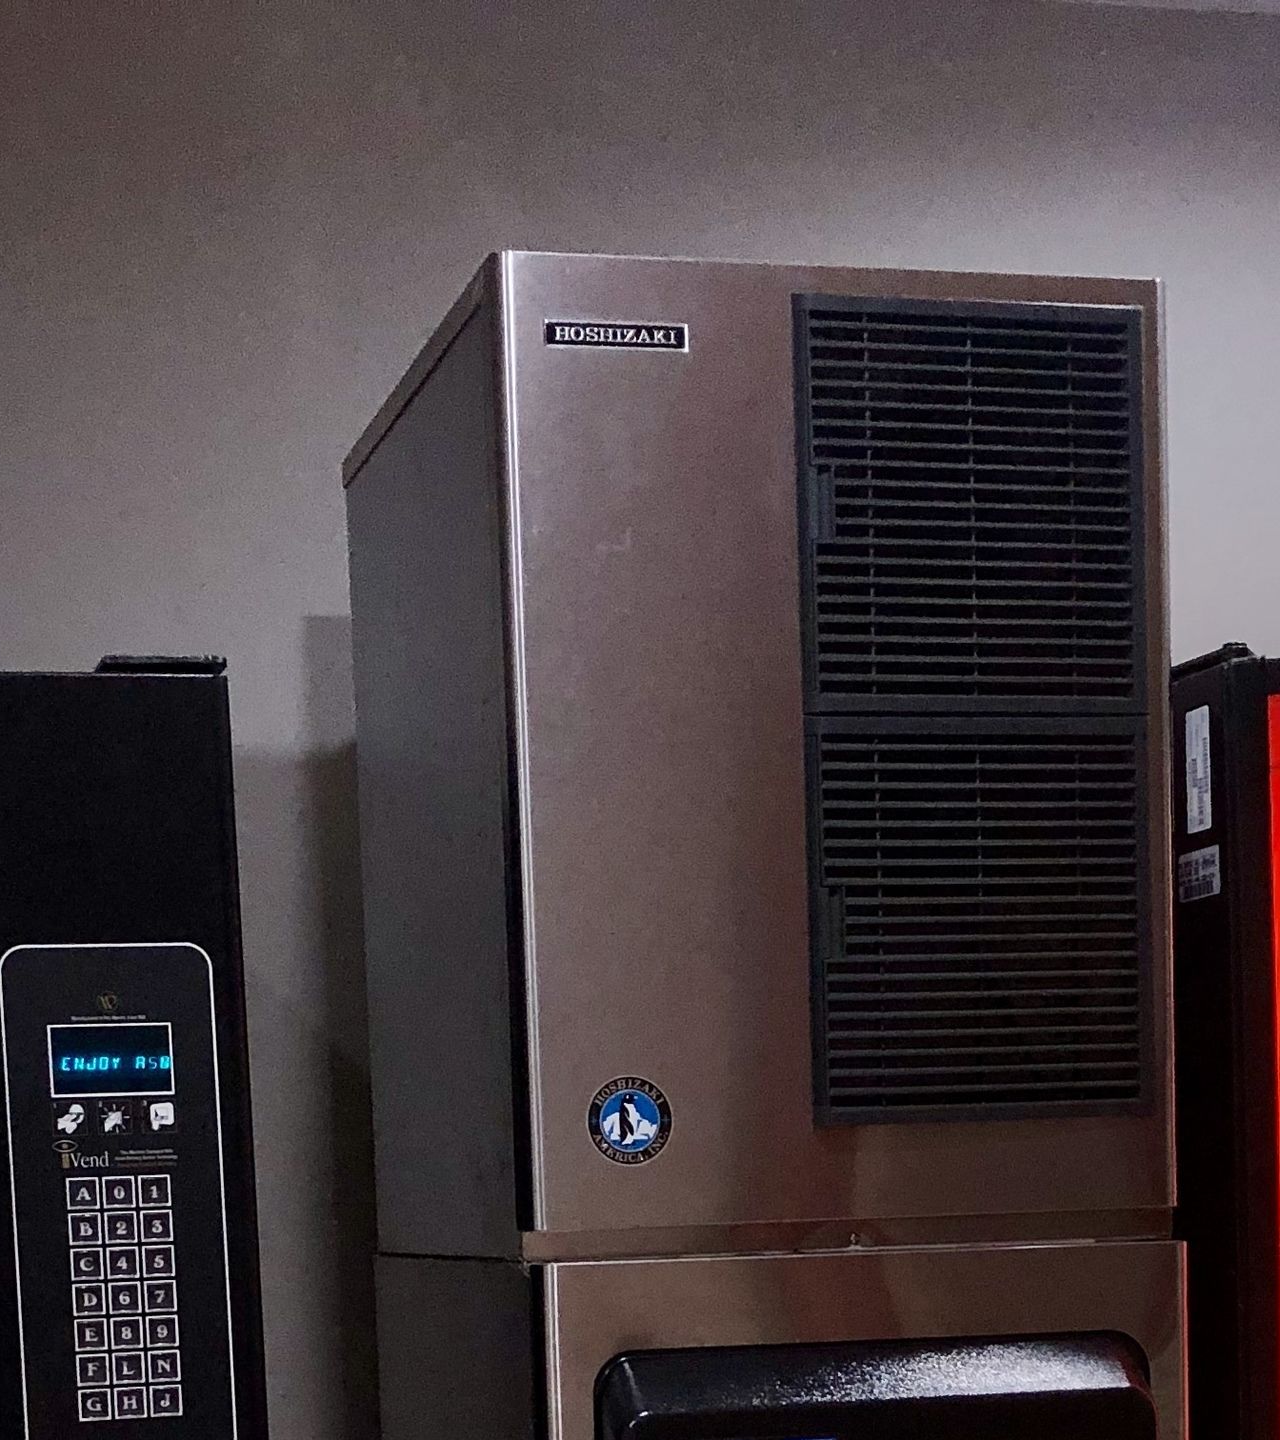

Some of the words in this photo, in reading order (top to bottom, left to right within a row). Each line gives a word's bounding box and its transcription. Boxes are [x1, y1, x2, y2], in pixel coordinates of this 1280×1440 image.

[554, 325, 678, 345] HOSHIZAKI
[60, 1056, 121, 1072] ENJOY
[75, 1186, 92, 1201] A
[113, 1186, 126, 1200] 0
[149, 1185, 159, 1199] 1
[78, 1221, 93, 1237] B
[115, 1220, 128, 1236] 2
[151, 1219, 163, 1234] 3
[79, 1256, 94, 1272] C
[116, 1256, 129, 1271] 4
[153, 1254, 165, 1269] 5
[82, 1292, 98, 1307] D
[118, 1291, 131, 1305] 6
[154, 1289, 166, 1304] 7
[84, 1327, 99, 1343] E
[121, 1326, 132, 1341] 8
[156, 1324, 168, 1339] 9
[86, 1362, 100, 1377] F
[121, 1360, 135, 1376] L
[156, 1358, 171, 1374] N
[86, 1396, 102, 1412] G
[122, 1395, 138, 1411] H
[159, 1394, 171, 1409] J
